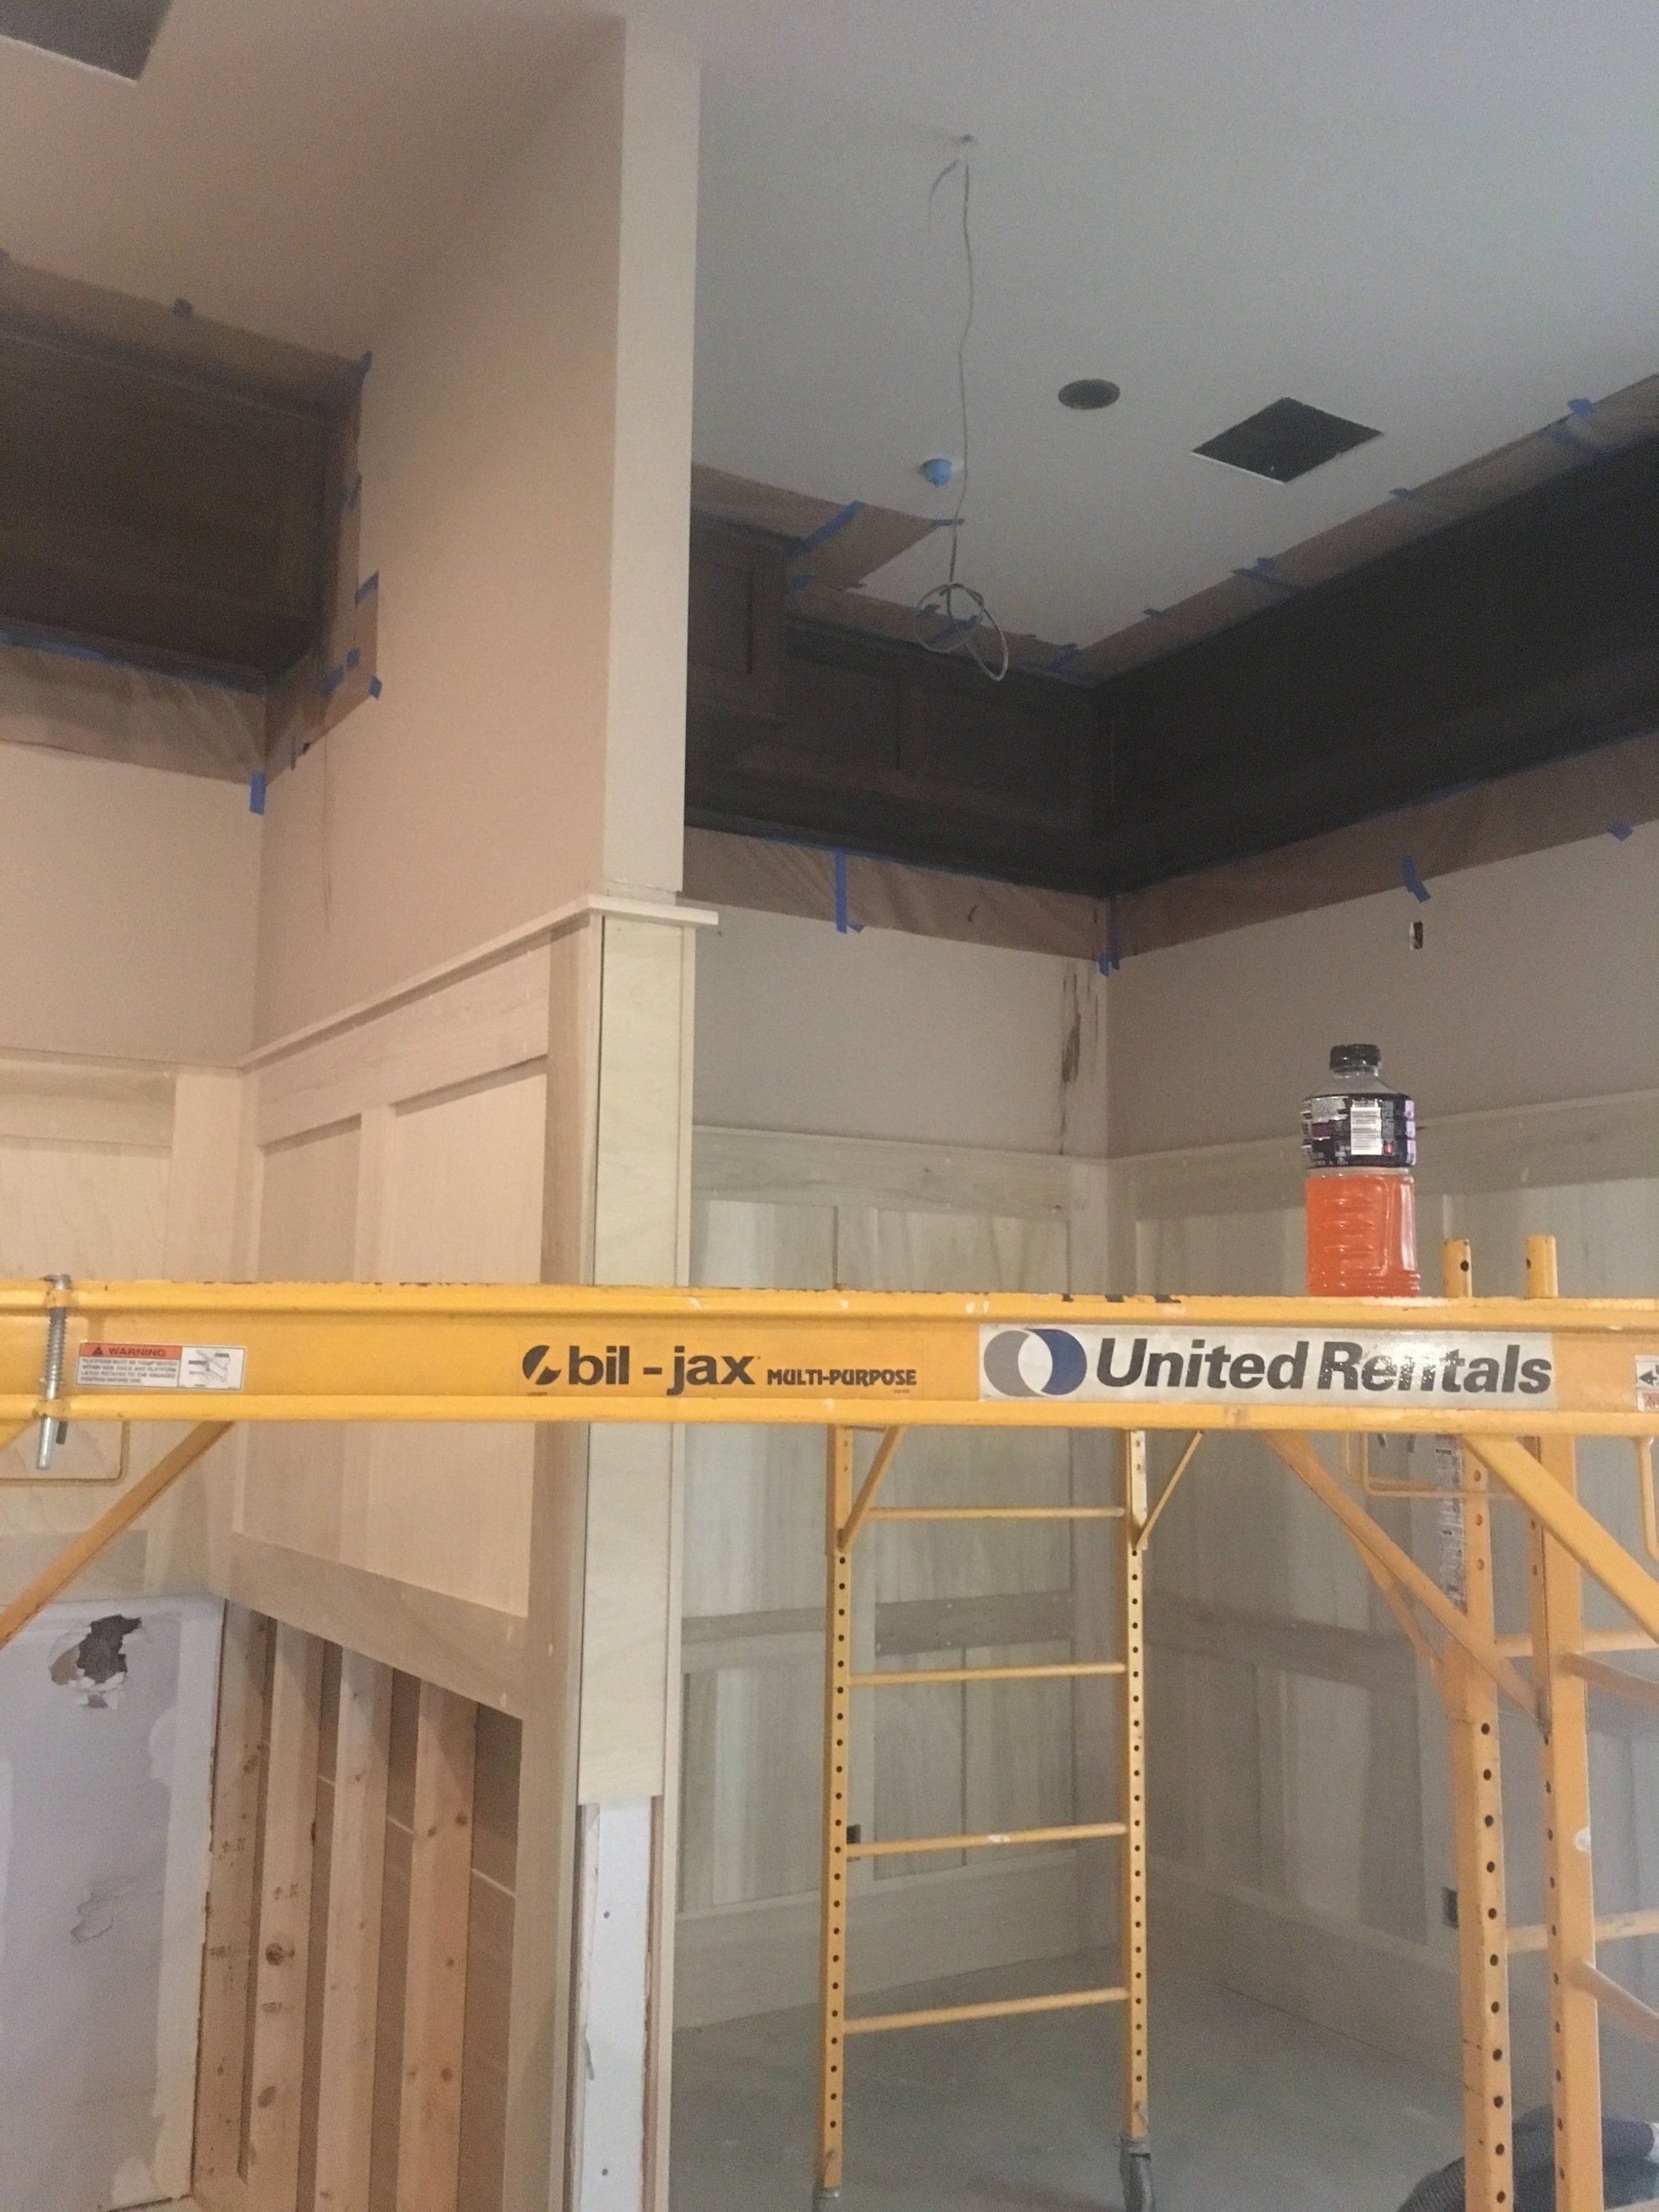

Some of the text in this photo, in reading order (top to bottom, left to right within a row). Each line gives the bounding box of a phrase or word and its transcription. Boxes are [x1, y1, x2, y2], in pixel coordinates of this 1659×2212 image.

[108, 1347, 167, 1357] WARNING
[1096, 1338, 1553, 1394] United Rentals
[766, 1369, 918, 1387] MULTI-PURPOSE
